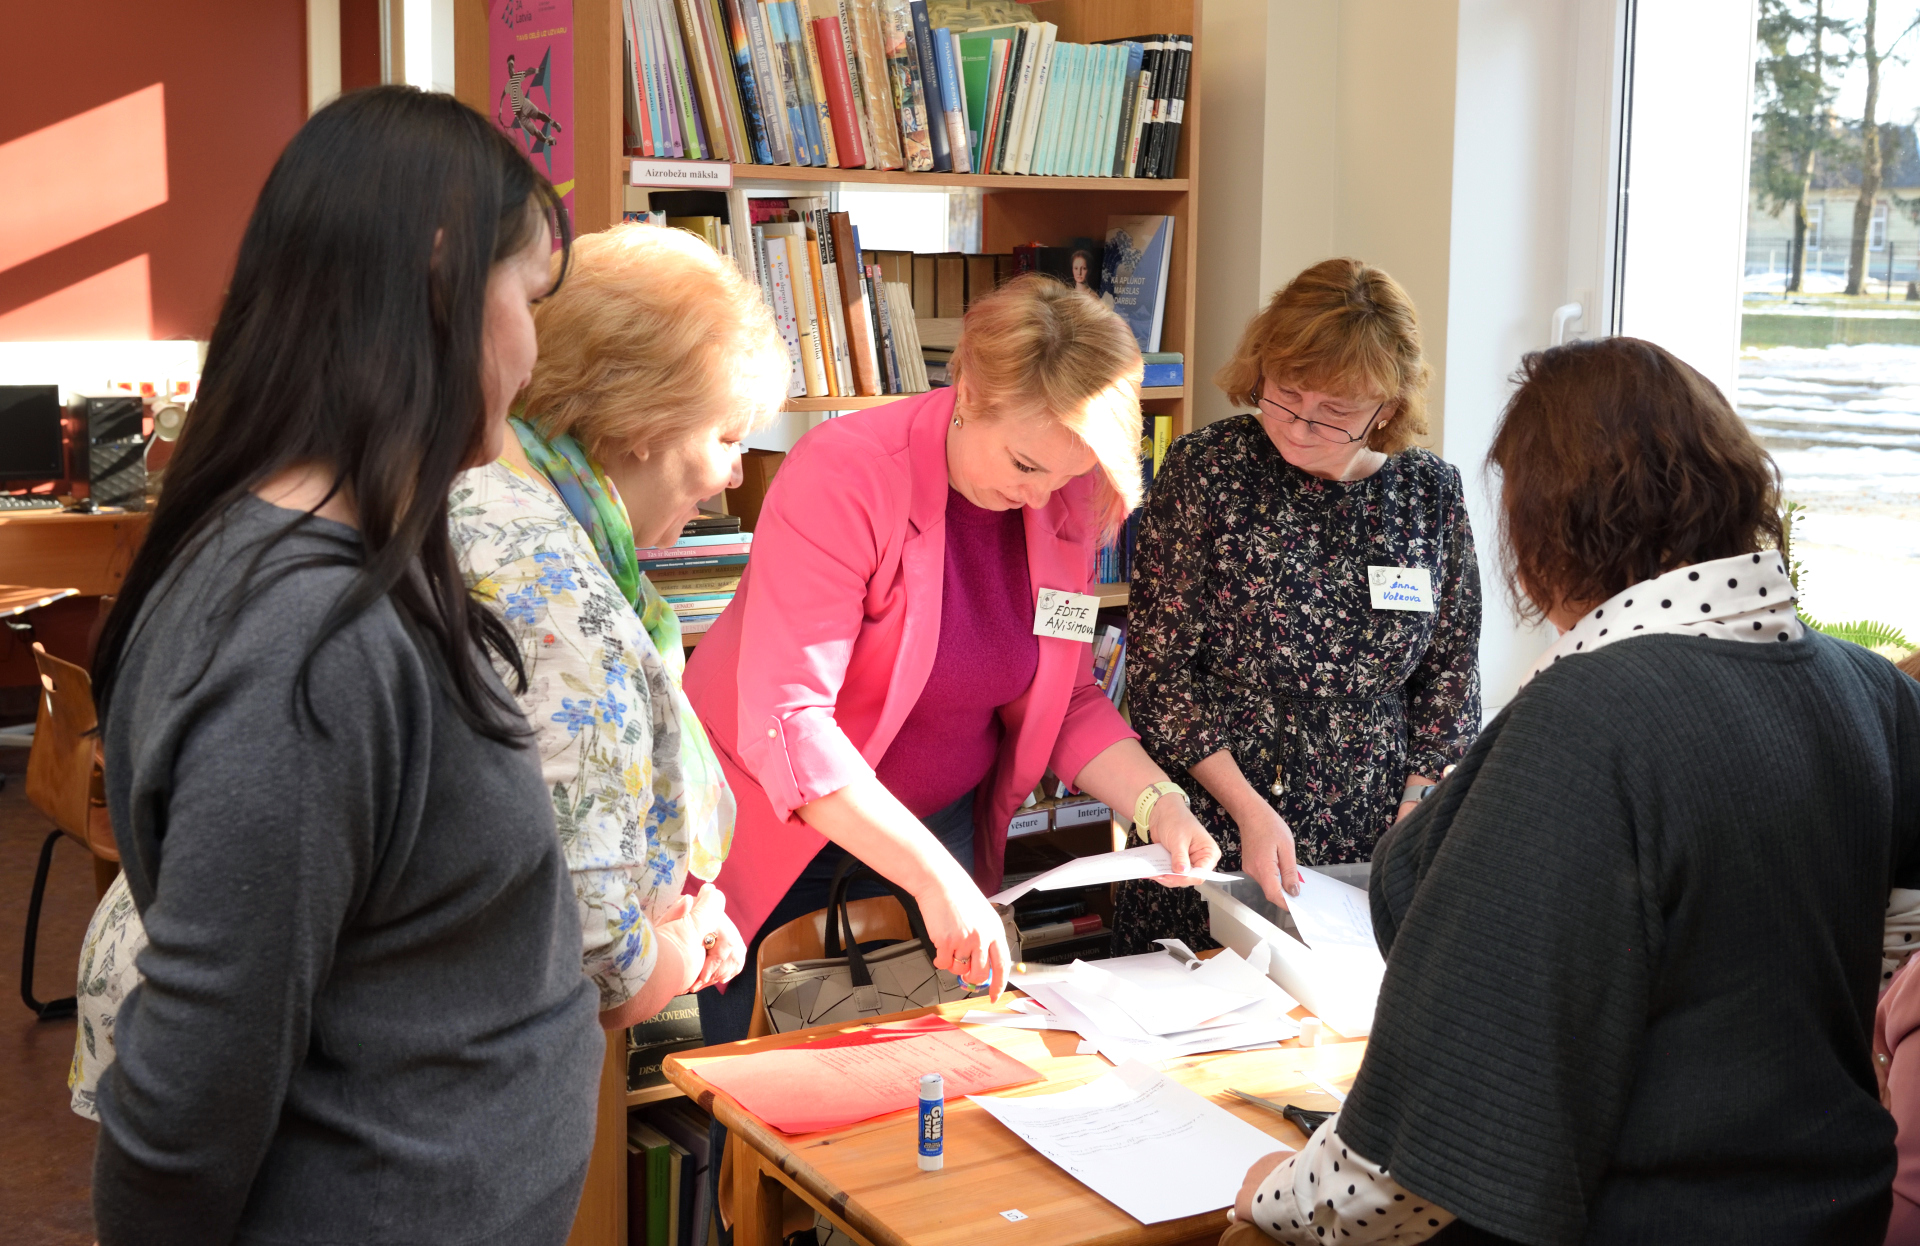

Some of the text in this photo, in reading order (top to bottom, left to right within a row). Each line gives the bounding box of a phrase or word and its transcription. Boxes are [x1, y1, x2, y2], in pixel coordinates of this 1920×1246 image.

[921, 26, 934, 59] SKAISTUMA
[920, 42, 931, 69] UMBERTO
[645, 168, 718, 178] Aizrobežu māksla
[1120, 275, 1146, 285] APLŪKOT
[1114, 286, 1139, 295] MĀKSLAS
[1114, 296, 1136, 305] DARBUS
[663, 547, 695, 557] Rembrants
[1383, 592, 1421, 602] Volkova
[1054, 605, 1089, 619] EDITE
[1011, 819, 1038, 830] vēsture
[924, 1114, 932, 1139] STICK
[931, 1105, 941, 1140] GLUE
